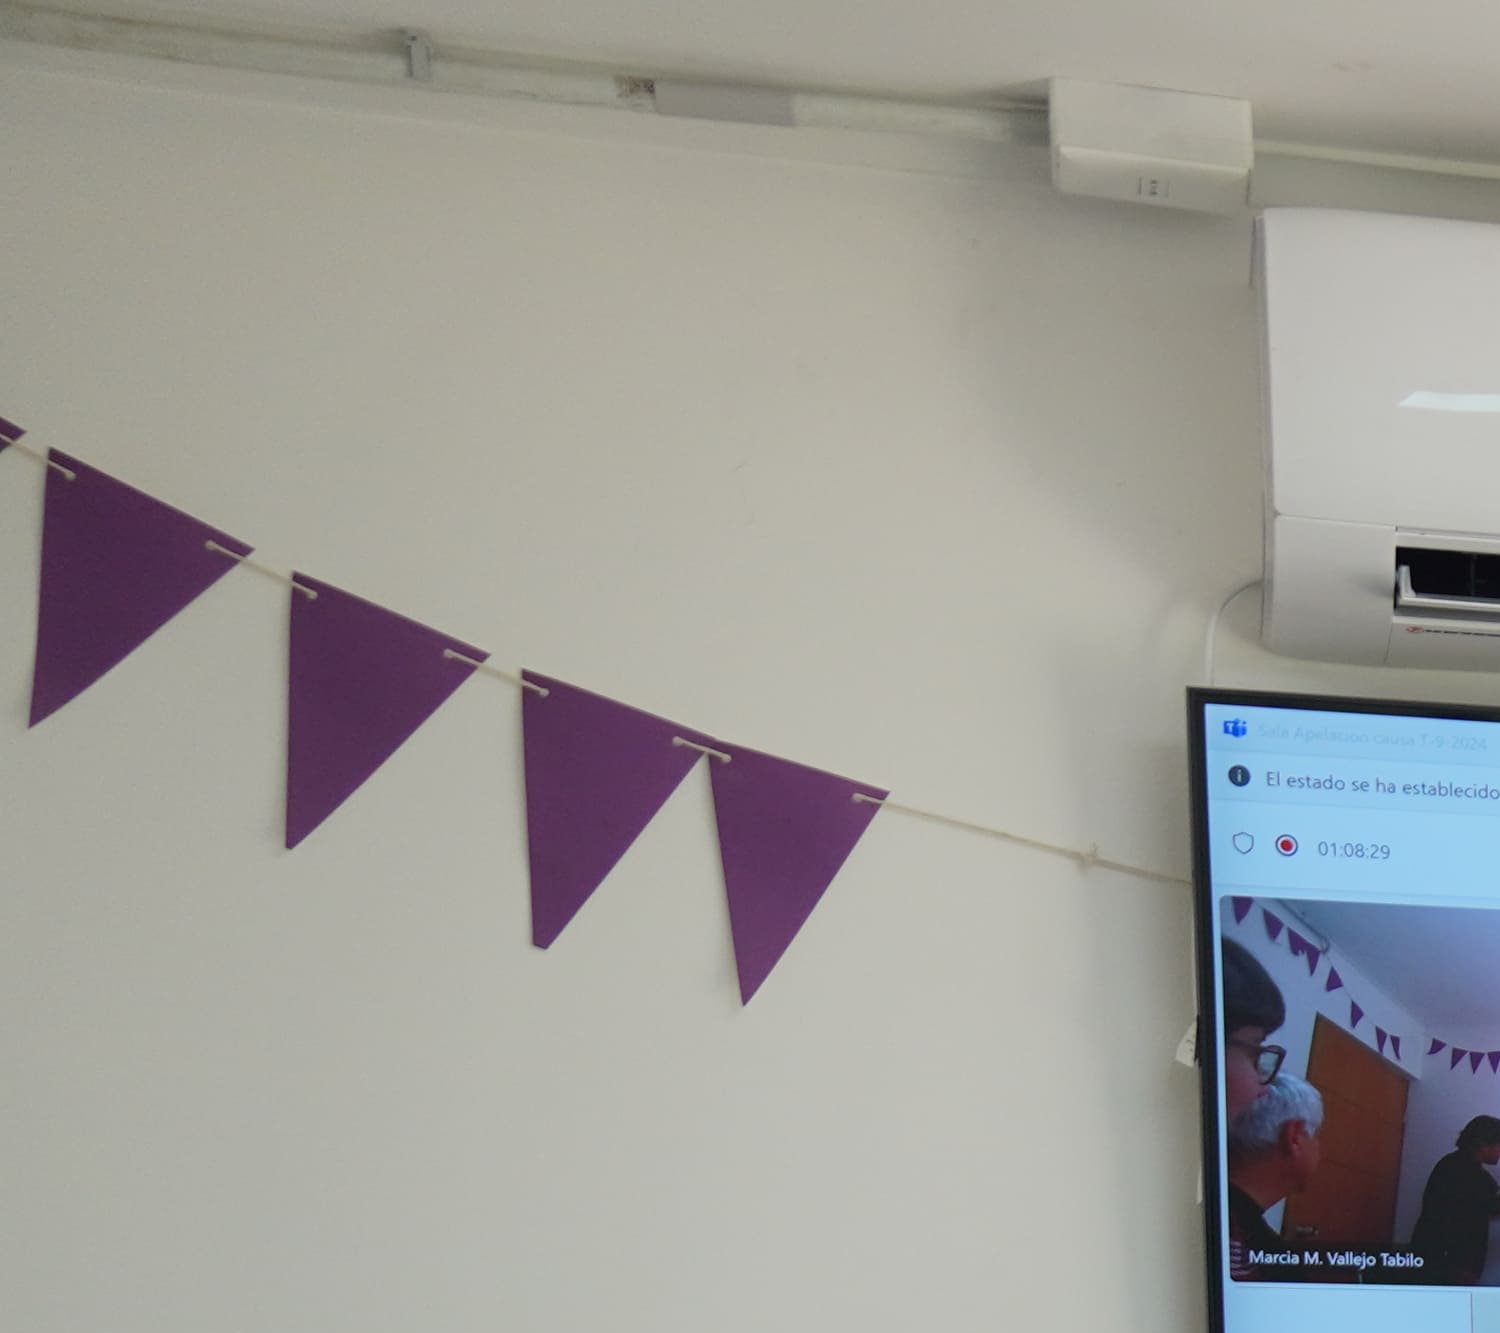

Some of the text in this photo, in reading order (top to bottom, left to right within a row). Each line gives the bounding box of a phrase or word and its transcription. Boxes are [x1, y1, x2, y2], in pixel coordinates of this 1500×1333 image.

[1266, 772, 1280, 787] El
[1286, 775, 1345, 791] estado
[1351, 780, 1369, 793] se
[1375, 778, 1396, 794] ha
[1402, 781, 1500, 800] establecido
[1318, 841, 1390, 860] 01:08:29
[1249, 1251, 1424, 1270] Marcia M. Vallejo Tabilo
